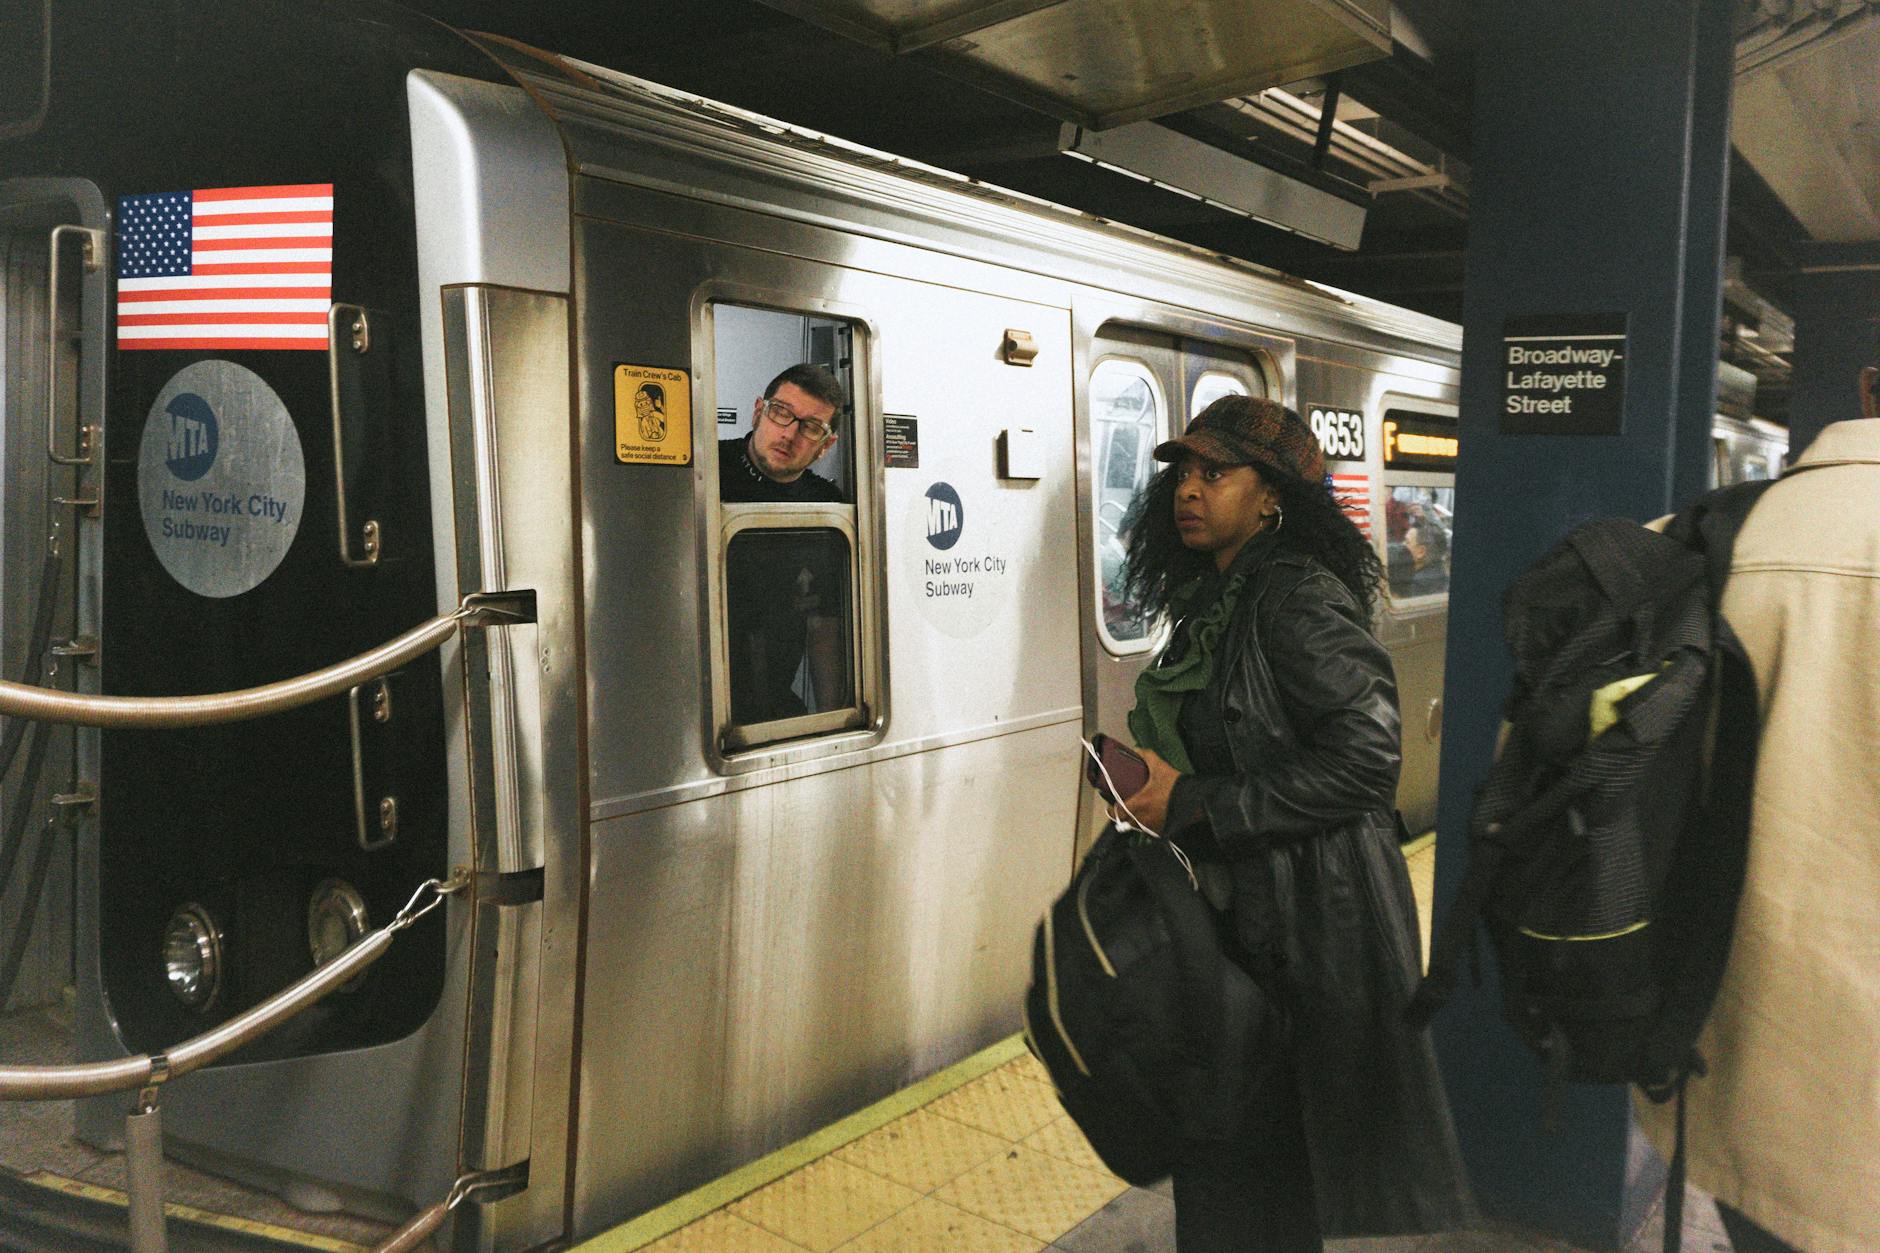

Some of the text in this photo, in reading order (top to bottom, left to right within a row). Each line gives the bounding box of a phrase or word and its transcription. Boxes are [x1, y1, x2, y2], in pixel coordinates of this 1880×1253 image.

[1508, 345, 1623, 368] Broadway-
[623, 368, 642, 377] Train
[667, 372, 682, 382] Cab
[1507, 370, 1607, 392] Lafayette
[1506, 395, 1572, 414] Street
[1310, 409, 1364, 457] 9653
[1383, 421, 1397, 462] F
[620, 443, 641, 451] Please
[641, 444, 657, 453] keep
[620, 451, 634, 459] safe
[652, 453, 676, 461] distance
[162, 490, 287, 523] New York City
[162, 517, 230, 547] Subway
[925, 556, 1007, 575] New York City
[925, 580, 974, 599] Subway
